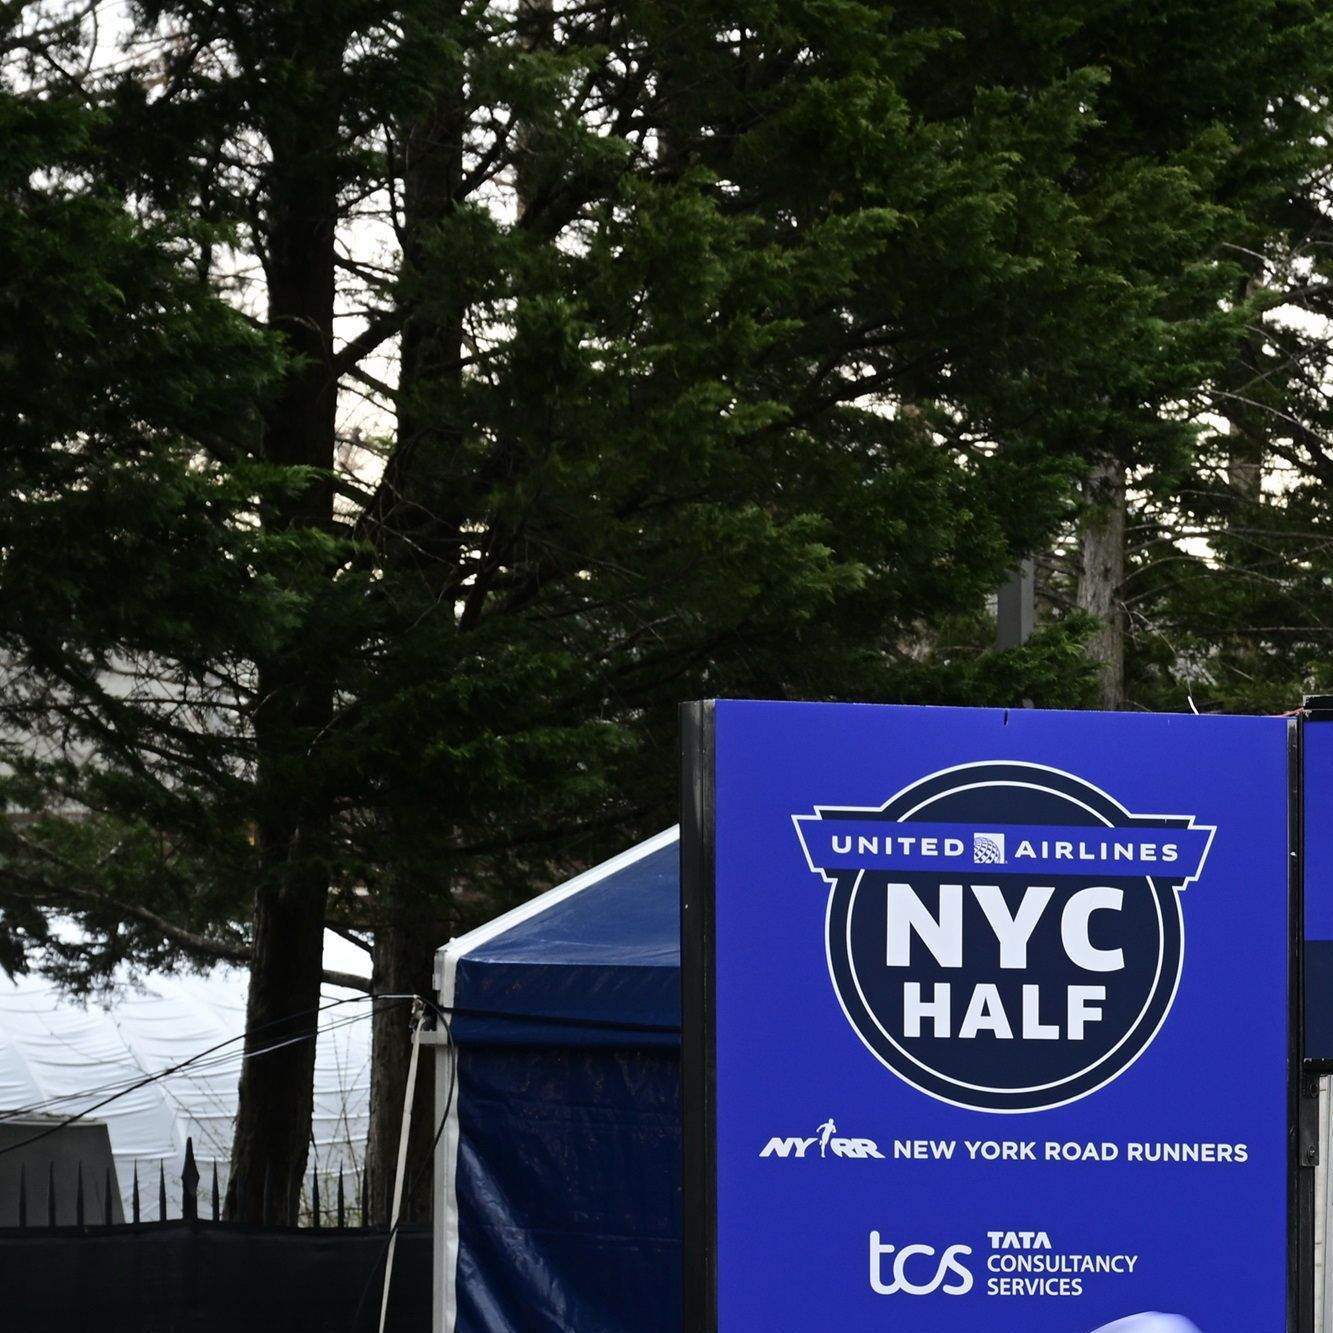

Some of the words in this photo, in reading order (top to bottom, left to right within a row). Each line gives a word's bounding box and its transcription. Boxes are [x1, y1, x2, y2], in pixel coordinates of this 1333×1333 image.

[832, 836, 964, 856] UNITED
[1015, 841, 1177, 861] AIRLINES
[887, 883, 1124, 971] NYC
[904, 982, 1106, 1040] HALF
[894, 1140, 956, 1159] NEW
[965, 1141, 1036, 1159] YORK
[1046, 1142, 1118, 1160] ROAD
[1128, 1143, 1248, 1162] RUNNERS
[987, 1232, 1051, 1249] TATA
[870, 1231, 973, 1295] tcs
[988, 1255, 1137, 1272] CONSULTANCY
[988, 1278, 1082, 1295] SERVICES
